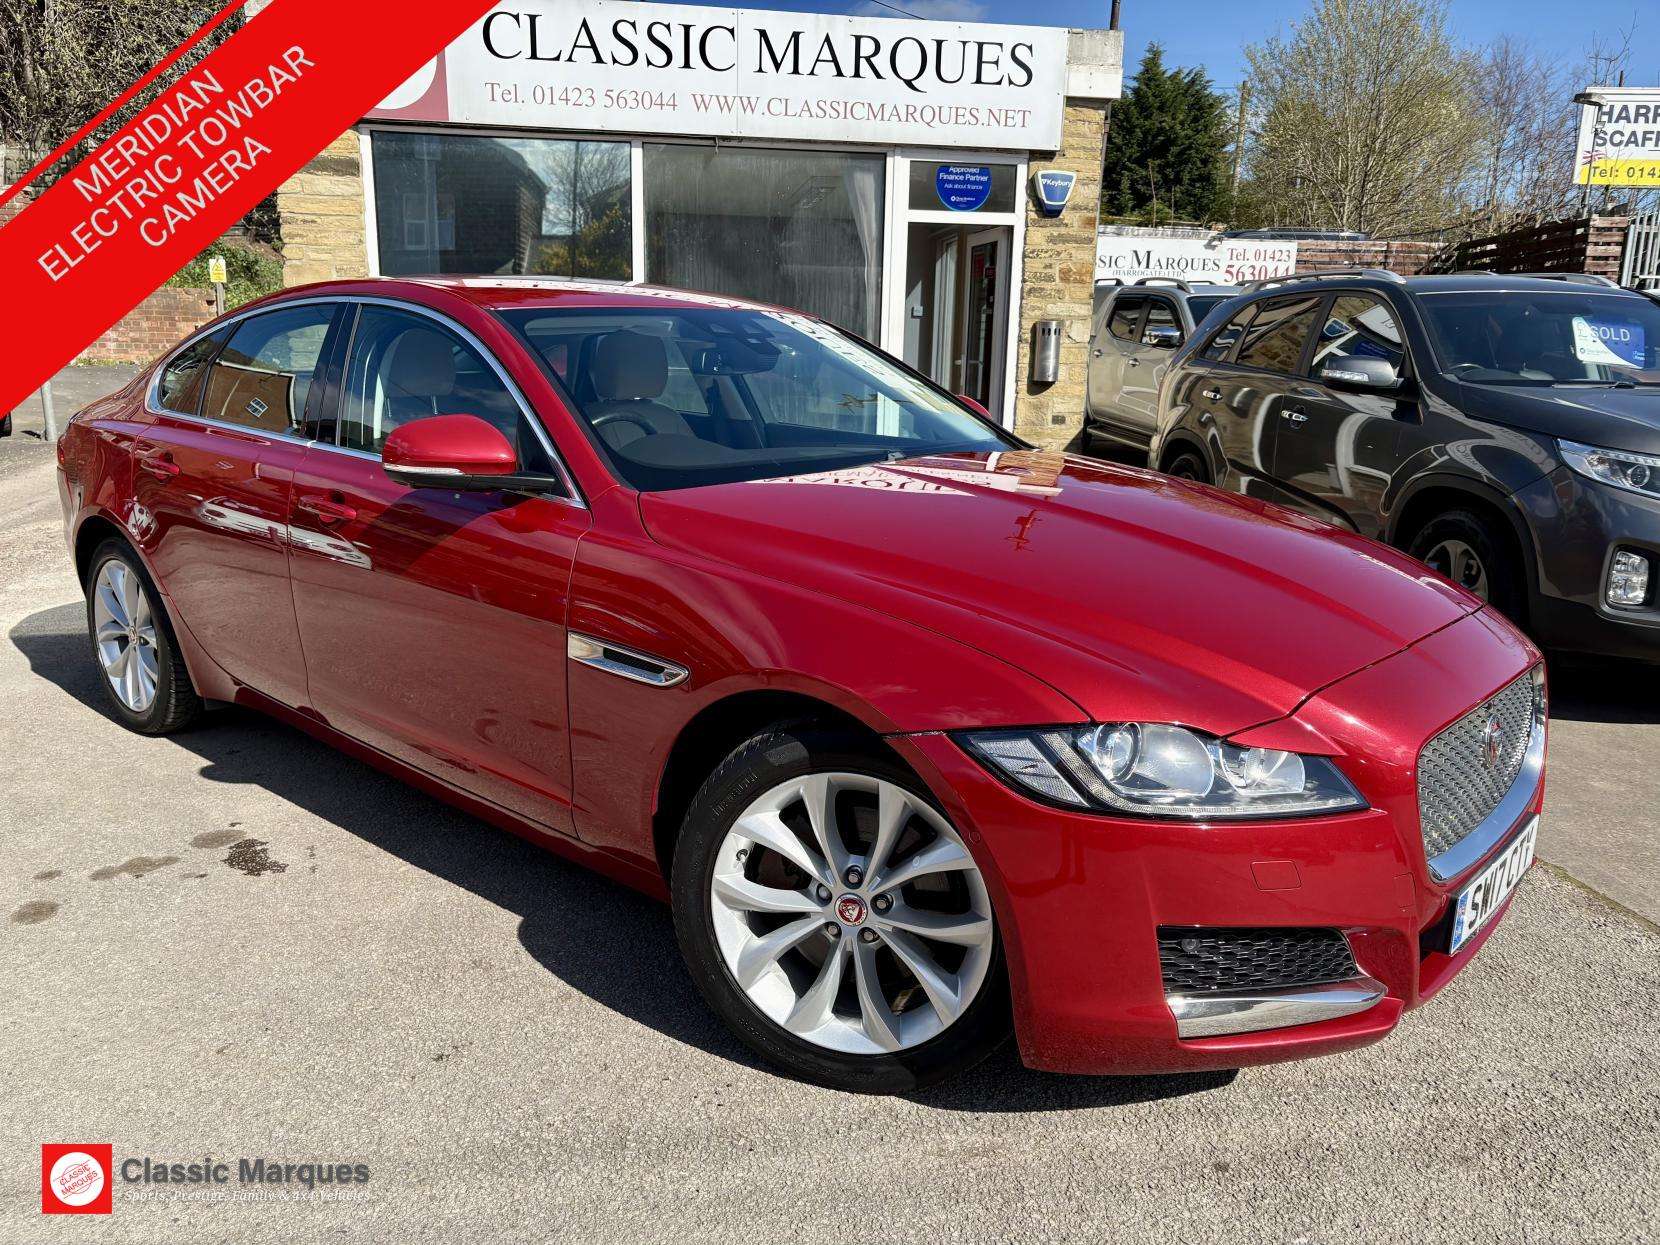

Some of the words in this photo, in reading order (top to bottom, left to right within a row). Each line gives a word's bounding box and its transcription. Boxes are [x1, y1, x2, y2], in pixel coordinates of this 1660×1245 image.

[482, 11, 736, 72] CLASSIC
[754, 28, 1034, 93] MARQUES
[485, 82, 525, 104] Tel.
[532, 84, 596, 107] 01423
[603, 88, 679, 112] 563044
[691, 93, 1032, 129] WWW.CLASSICMARQUES.NET
[939, 173, 965, 181] Finance
[965, 174, 989, 182] Partner
[948, 166, 980, 174] Approved
[1592, 166, 1619, 178] Tel:
[1130, 250, 1221, 273] MARQUES
[1227, 247, 1250, 261] Tel.
[1254, 248, 1291, 262] 01423
[1590, 325, 1631, 342] SOLD
